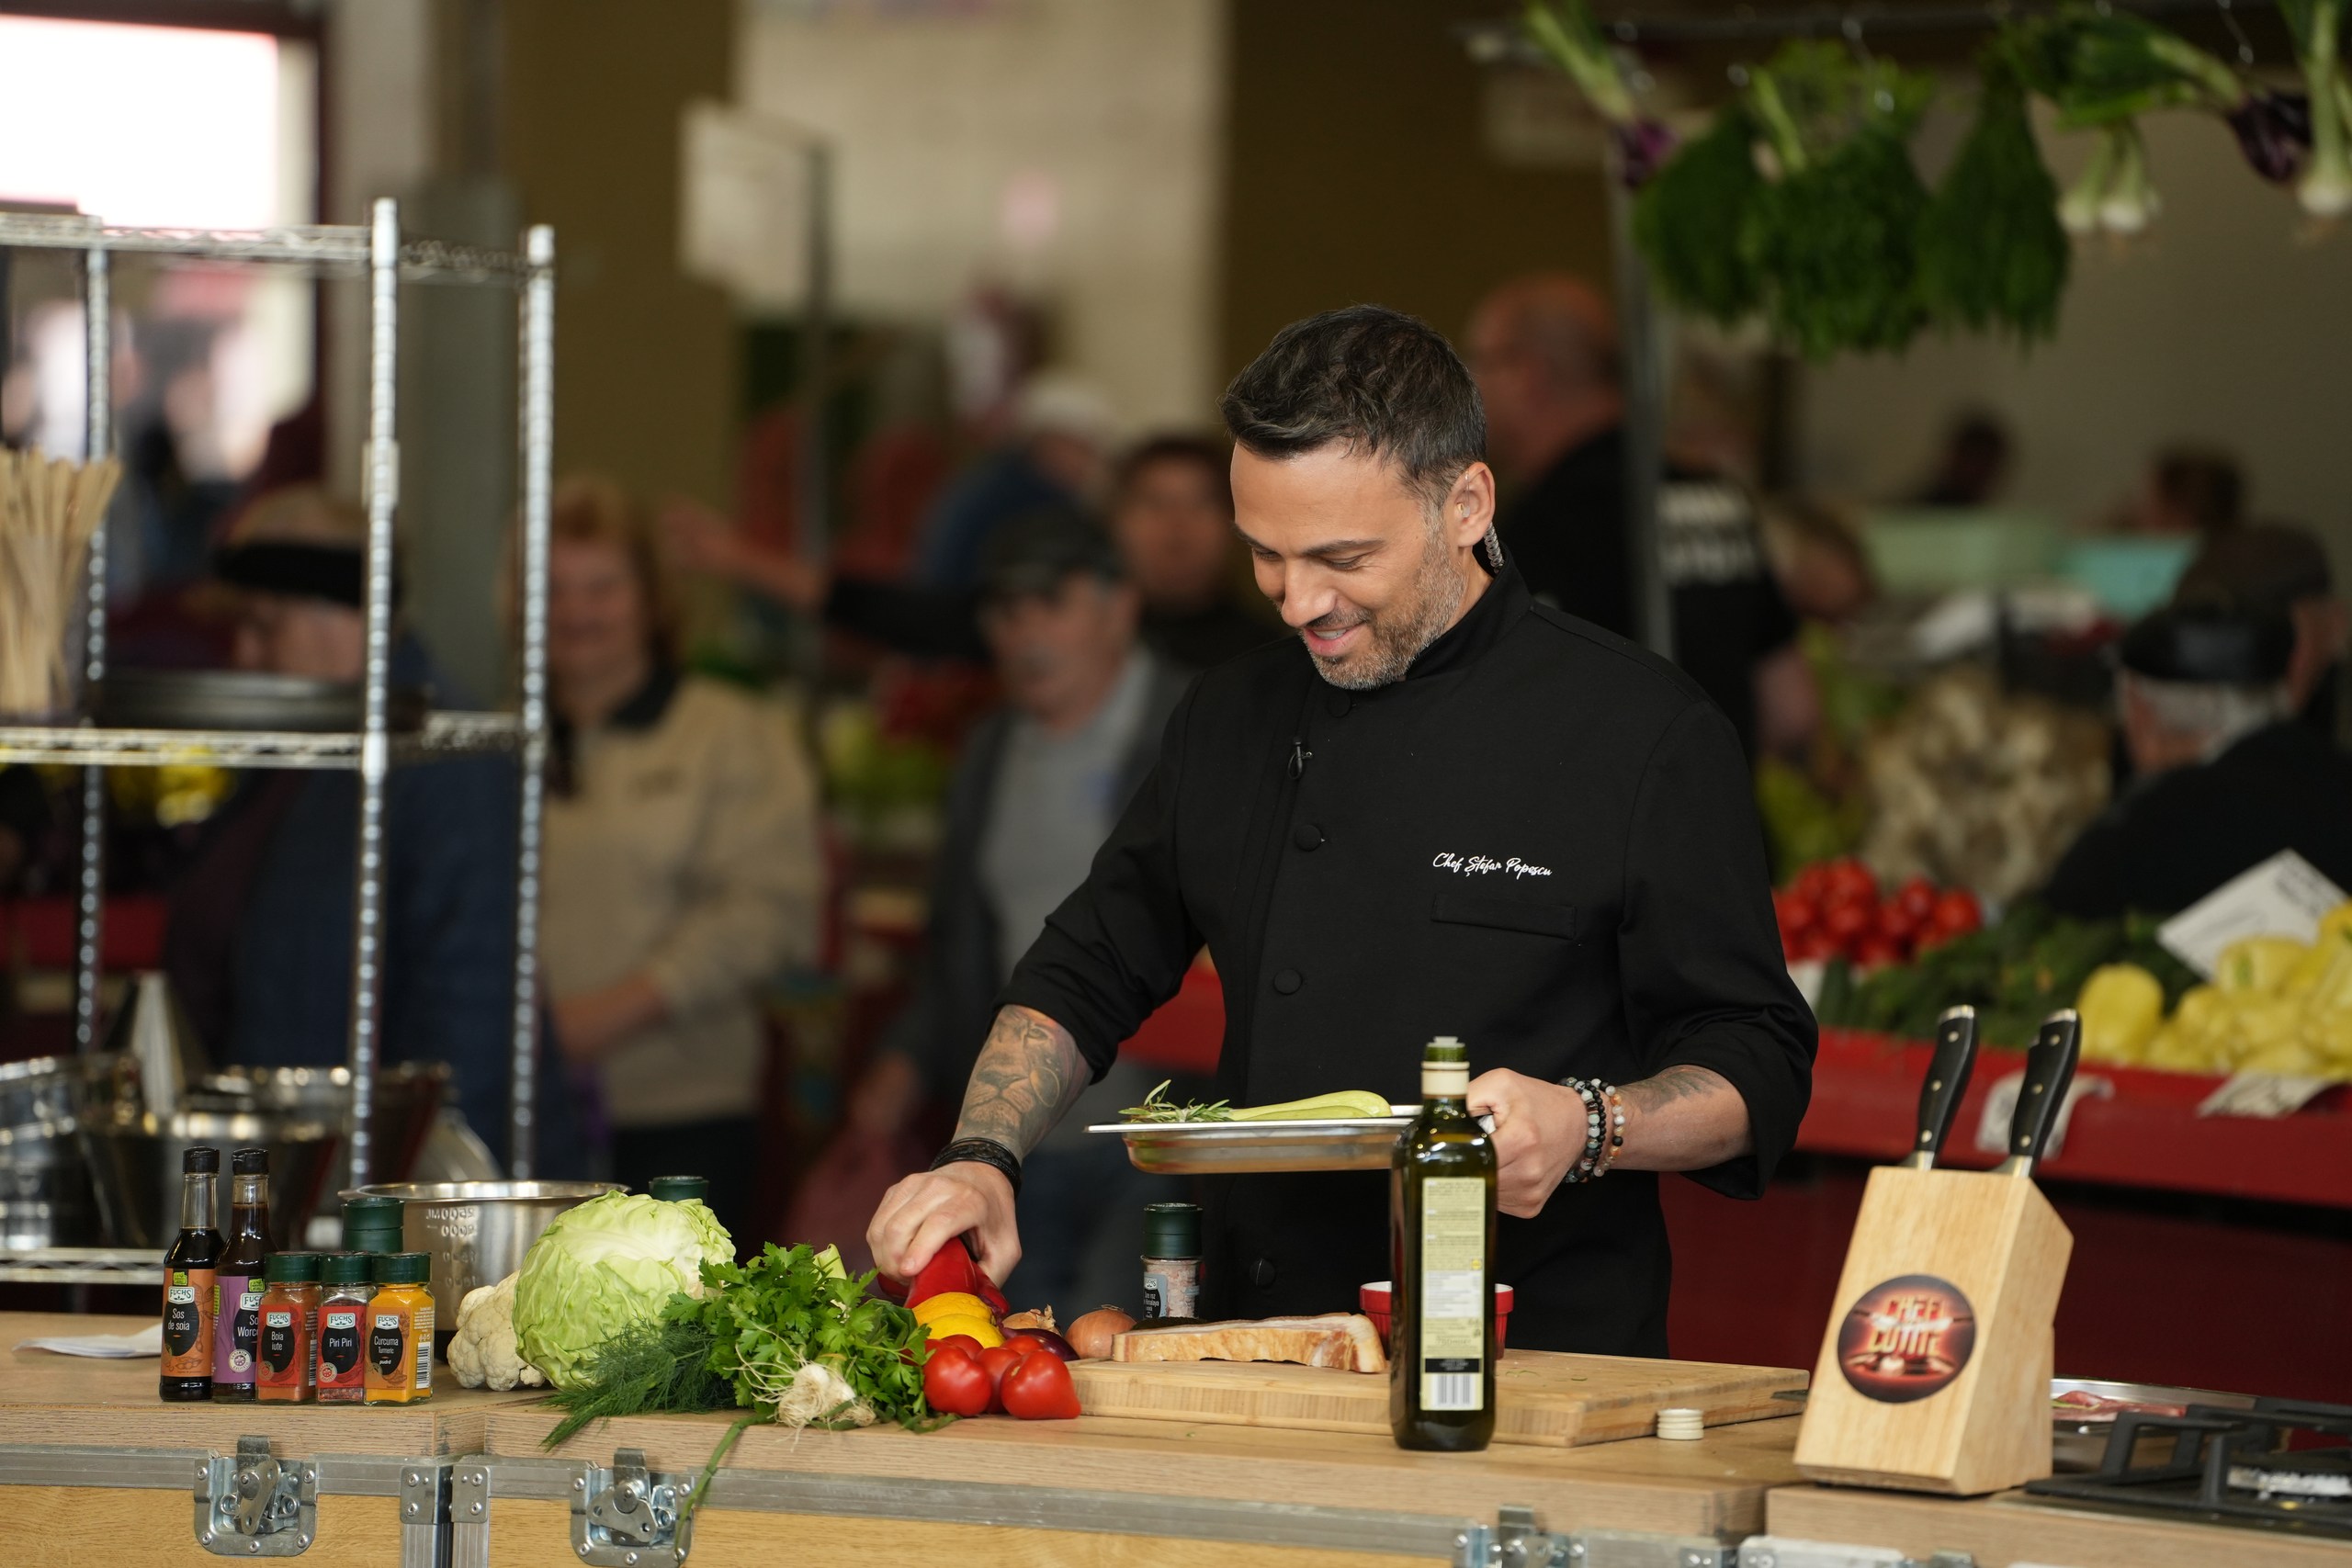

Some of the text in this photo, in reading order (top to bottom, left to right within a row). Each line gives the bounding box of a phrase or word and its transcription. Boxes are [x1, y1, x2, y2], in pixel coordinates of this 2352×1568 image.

[1432, 852, 1464, 873] Chef
[1506, 857, 1553, 880] Popescu
[170, 1289, 192, 1299] FUCHS
[243, 1296, 261, 1305] FUC
[172, 1308, 185, 1319] Sos
[249, 1314, 259, 1325] So
[269, 1314, 288, 1324] FUCHS
[330, 1315, 353, 1324] FUCHS
[378, 1316, 398, 1325] FUCHS
[167, 1320, 190, 1331] de soia
[271, 1331, 284, 1341] Boia
[374, 1336, 399, 1346] Curcuma
[271, 1342, 283, 1351] iute
[329, 1337, 353, 1348] Piri Piri
